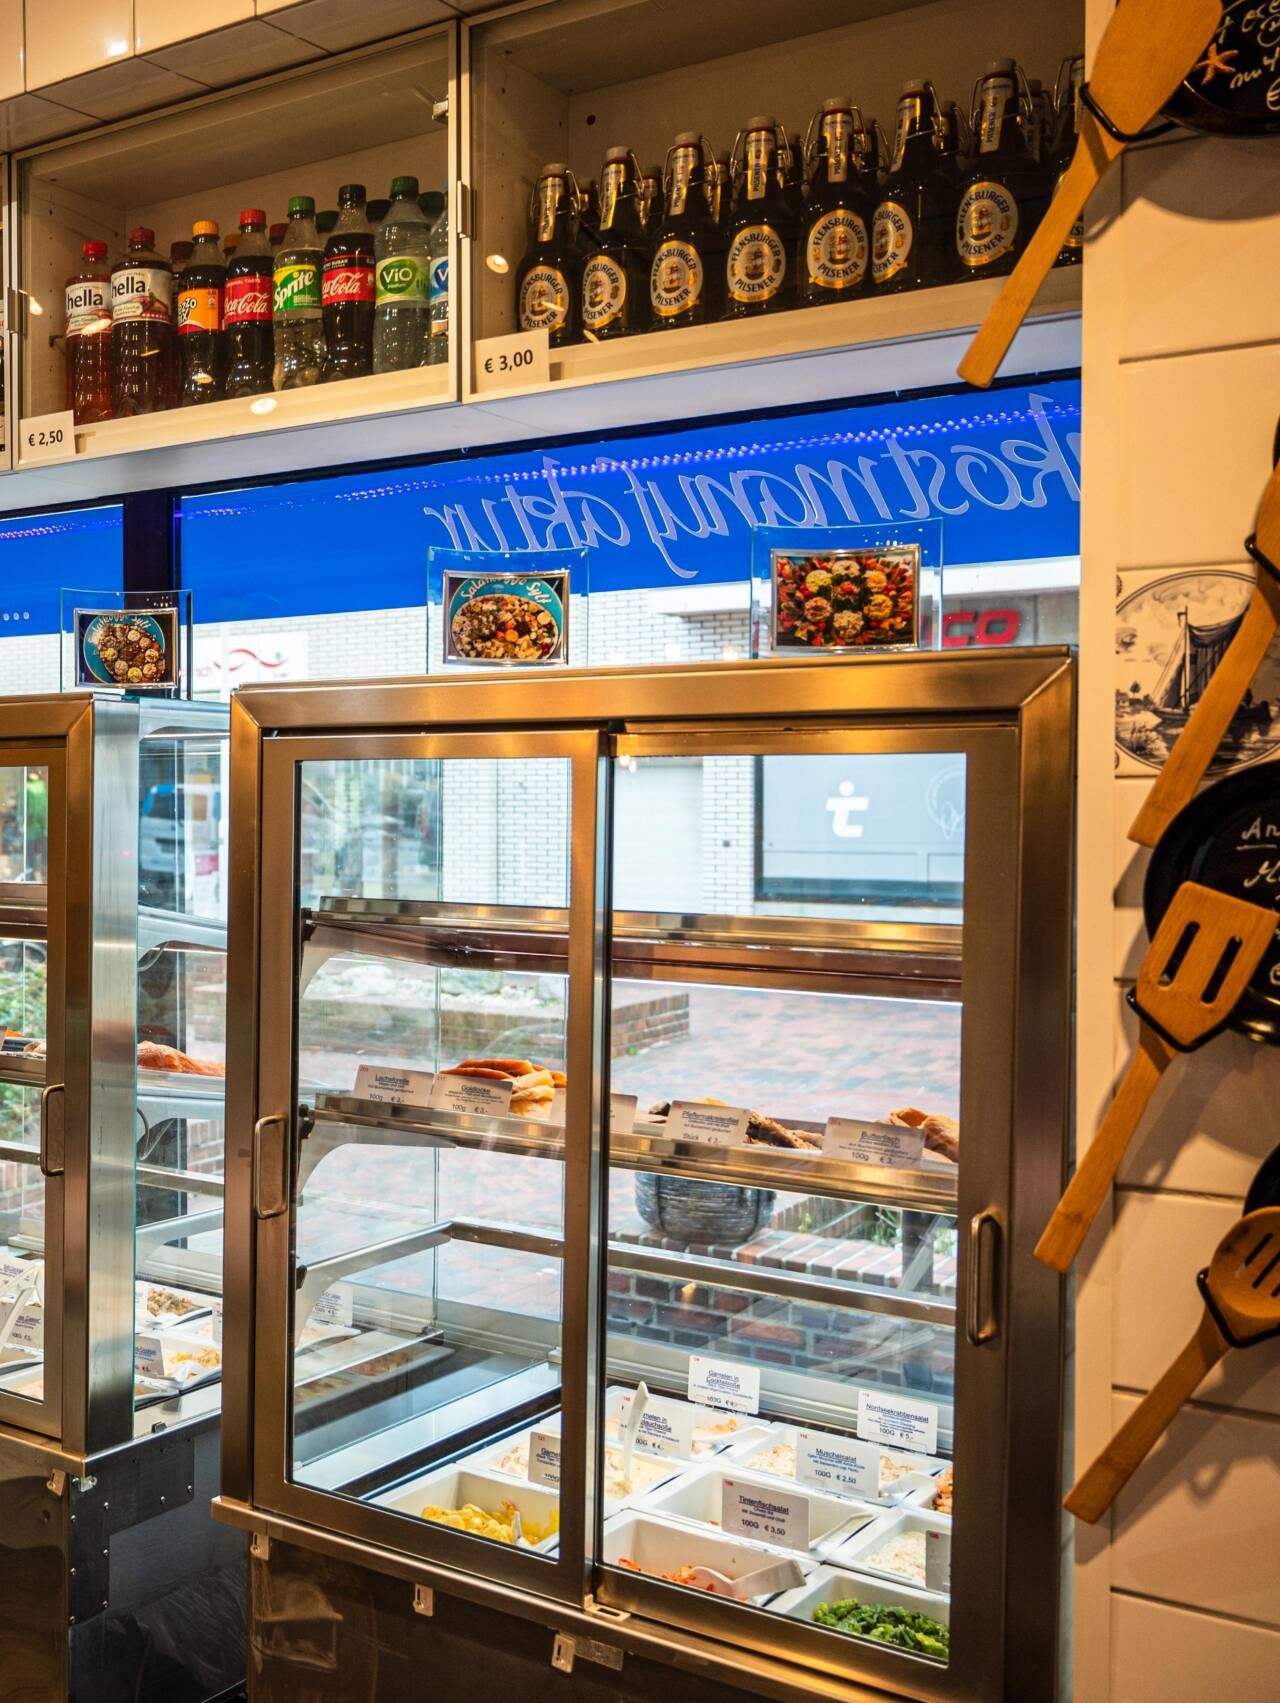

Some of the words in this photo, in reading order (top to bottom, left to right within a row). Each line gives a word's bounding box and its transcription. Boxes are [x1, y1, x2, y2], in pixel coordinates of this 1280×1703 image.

[813, 216, 864, 246] FLENSBURGER
[731, 232, 781, 262] FLENSBURGER
[817, 261, 860, 278] PILSENER
[274, 270, 314, 309] Sprite
[735, 274, 776, 293] PILSENER
[67, 289, 104, 311] hella
[654, 287, 691, 306] PILSENER
[523, 311, 558, 329] PILSENER
[484, 358, 495, 374] €
[498, 349, 534, 372] 3,00
[28, 432, 36, 446] €
[38, 428, 64, 446] 2,50
[815, 1447, 857, 1463] Muschelsalat
[813, 1468, 832, 1480] 100G
[835, 1473, 841, 1481] €
[741, 1518, 759, 1529] 100G
